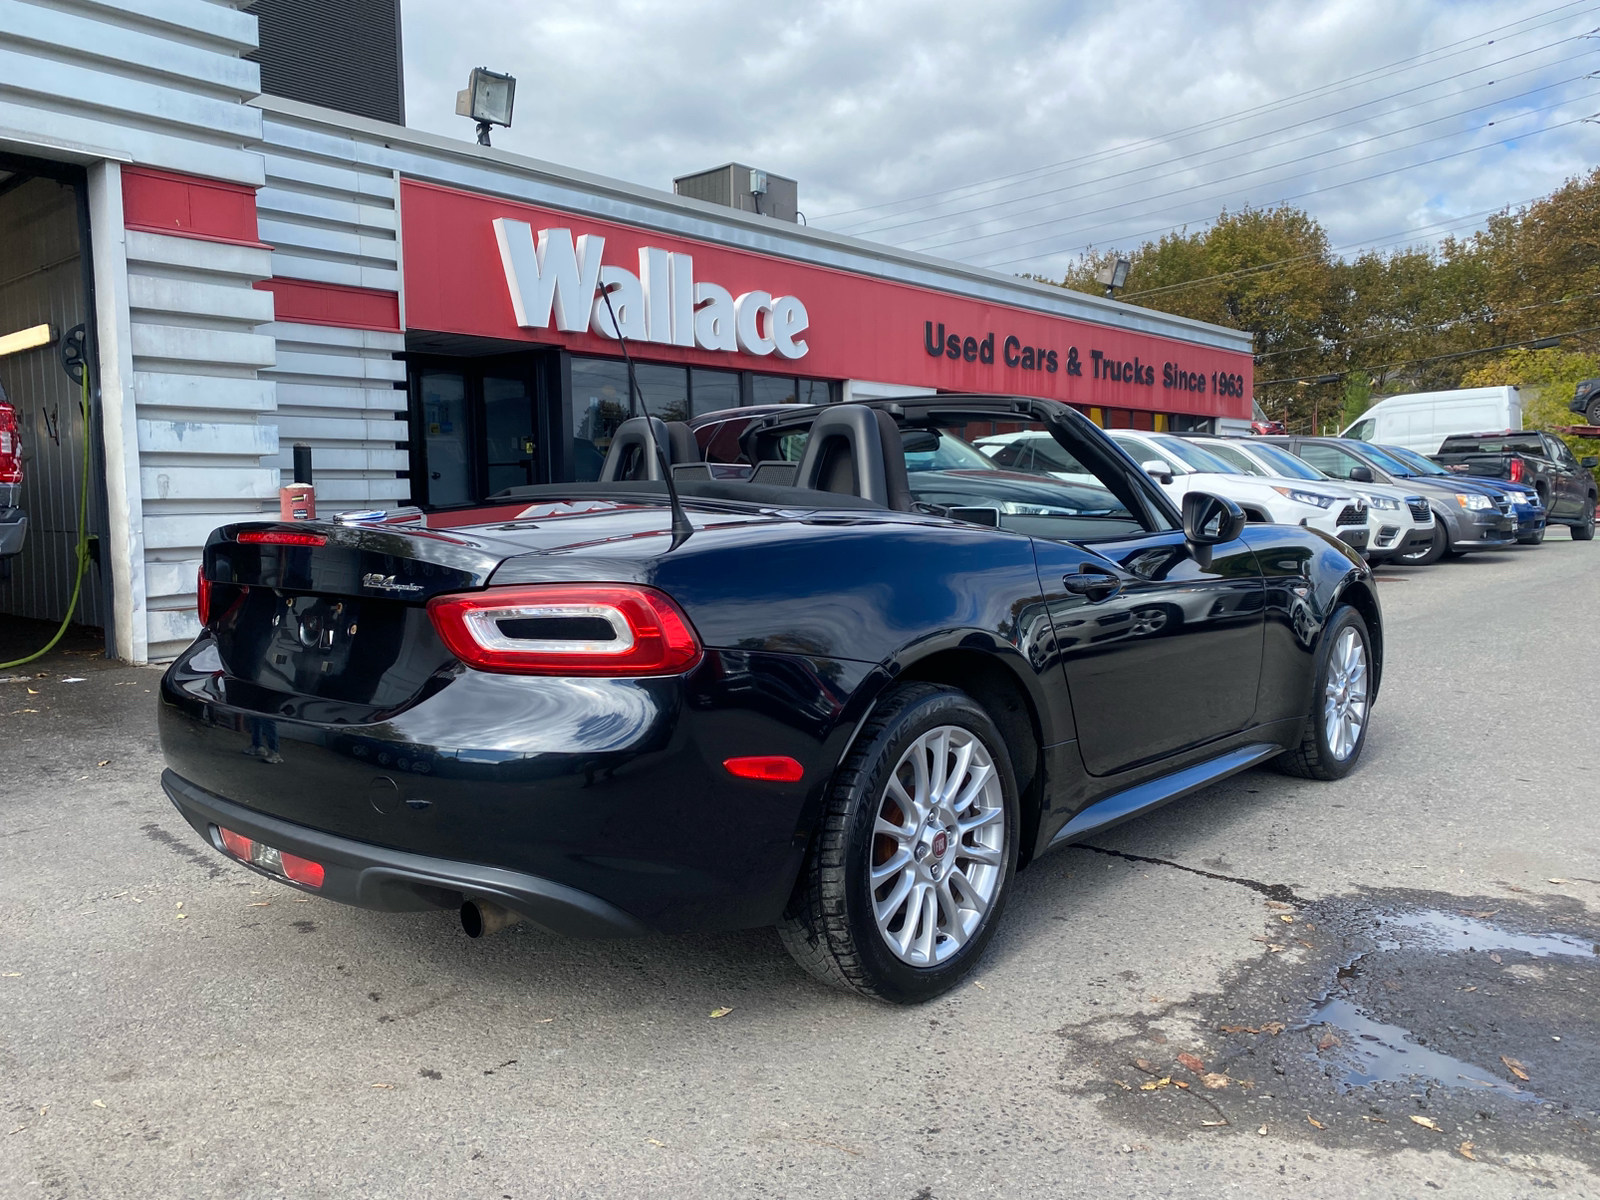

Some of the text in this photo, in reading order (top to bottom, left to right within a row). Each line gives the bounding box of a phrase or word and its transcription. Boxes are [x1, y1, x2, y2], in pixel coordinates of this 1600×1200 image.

[492, 217, 810, 360] Wallace
[924, 320, 1244, 398] Used Cars & Trucks Since 1963
[363, 573, 396, 591] 124
